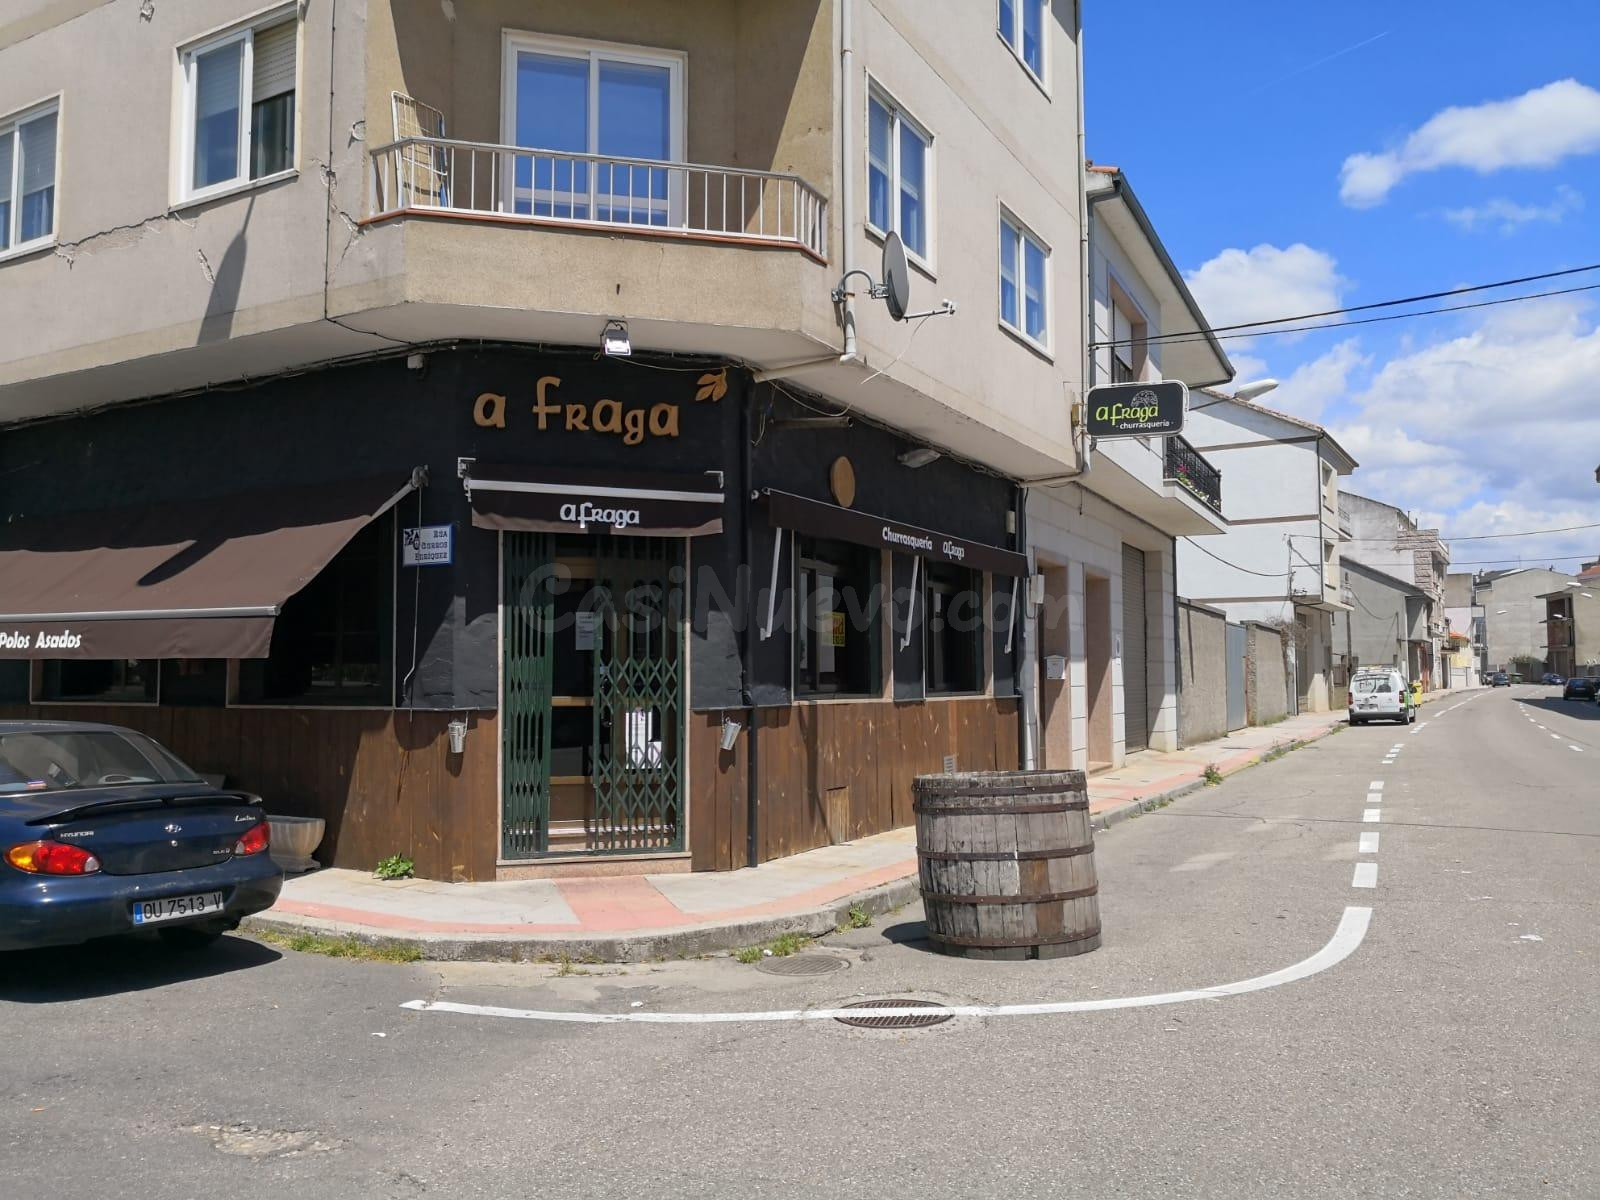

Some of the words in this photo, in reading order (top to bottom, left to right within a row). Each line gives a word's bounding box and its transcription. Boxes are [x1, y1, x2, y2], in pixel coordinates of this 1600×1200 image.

[473, 392, 506, 428] a
[0, 631, 31, 649] Polos
[34, 629, 82, 649] Asados
[143, 901, 163, 920] OU
[167, 896, 205, 917] 7513
[213, 893, 221, 909] V
